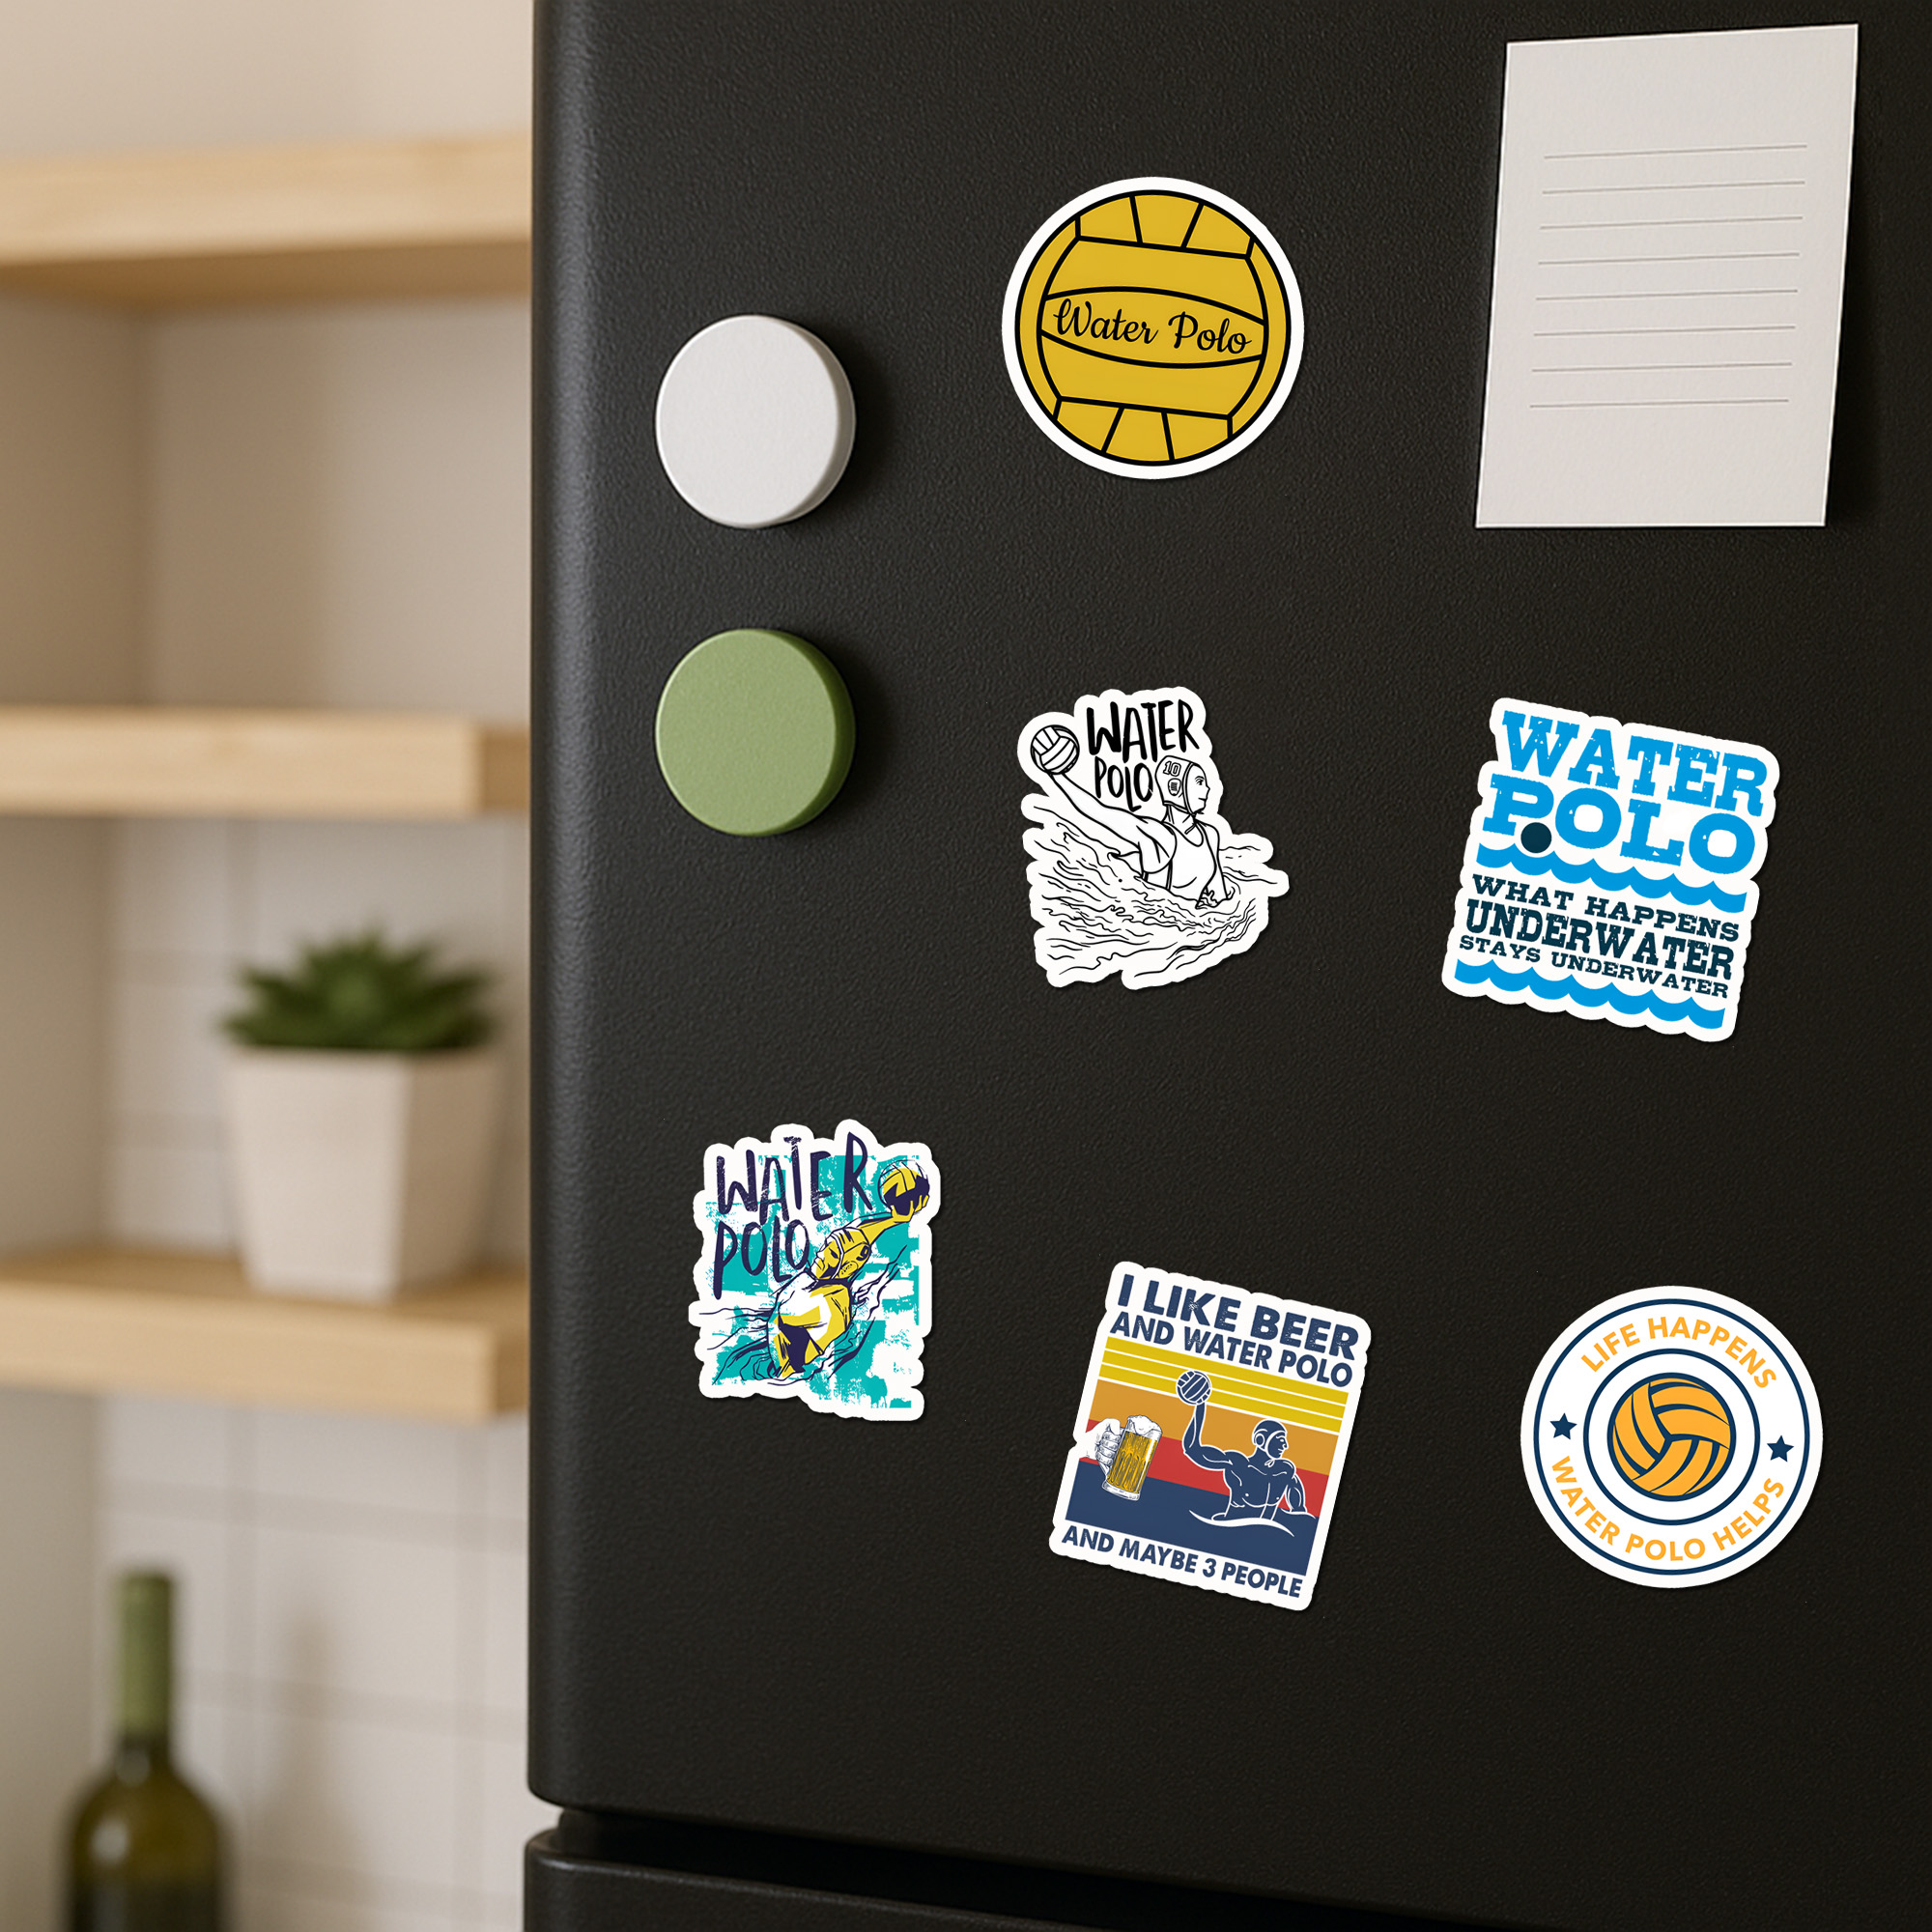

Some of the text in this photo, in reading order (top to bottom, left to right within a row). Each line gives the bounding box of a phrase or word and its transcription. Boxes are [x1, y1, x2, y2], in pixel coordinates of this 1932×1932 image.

[1053, 298, 1252, 354] Water Polo
[1087, 699, 1200, 763] WATER
[1163, 760, 1181, 777] 10
[1502, 710, 1768, 817] WATER
[1094, 755, 1153, 812] POLO
[1482, 773, 1755, 874] POLO
[1465, 898, 1735, 980] UNDERWATER
[1472, 873, 1739, 942] WHAT HAPPENS
[1459, 934, 1729, 999] STAYS UNDERWATER
[717, 1131, 873, 1226] WATER
[713, 1215, 810, 1299] POLO
[1109, 1311, 1352, 1388] AND WATER POLO
[1118, 1273, 1359, 1360] I LIKE BEER
[1580, 1317, 1776, 1388] LIFE HAPPENS
[1551, 1456, 1784, 1561] WATER POLO HELPS
[1062, 1525, 1303, 1598] AND MAYBE 3 PEOPLE
